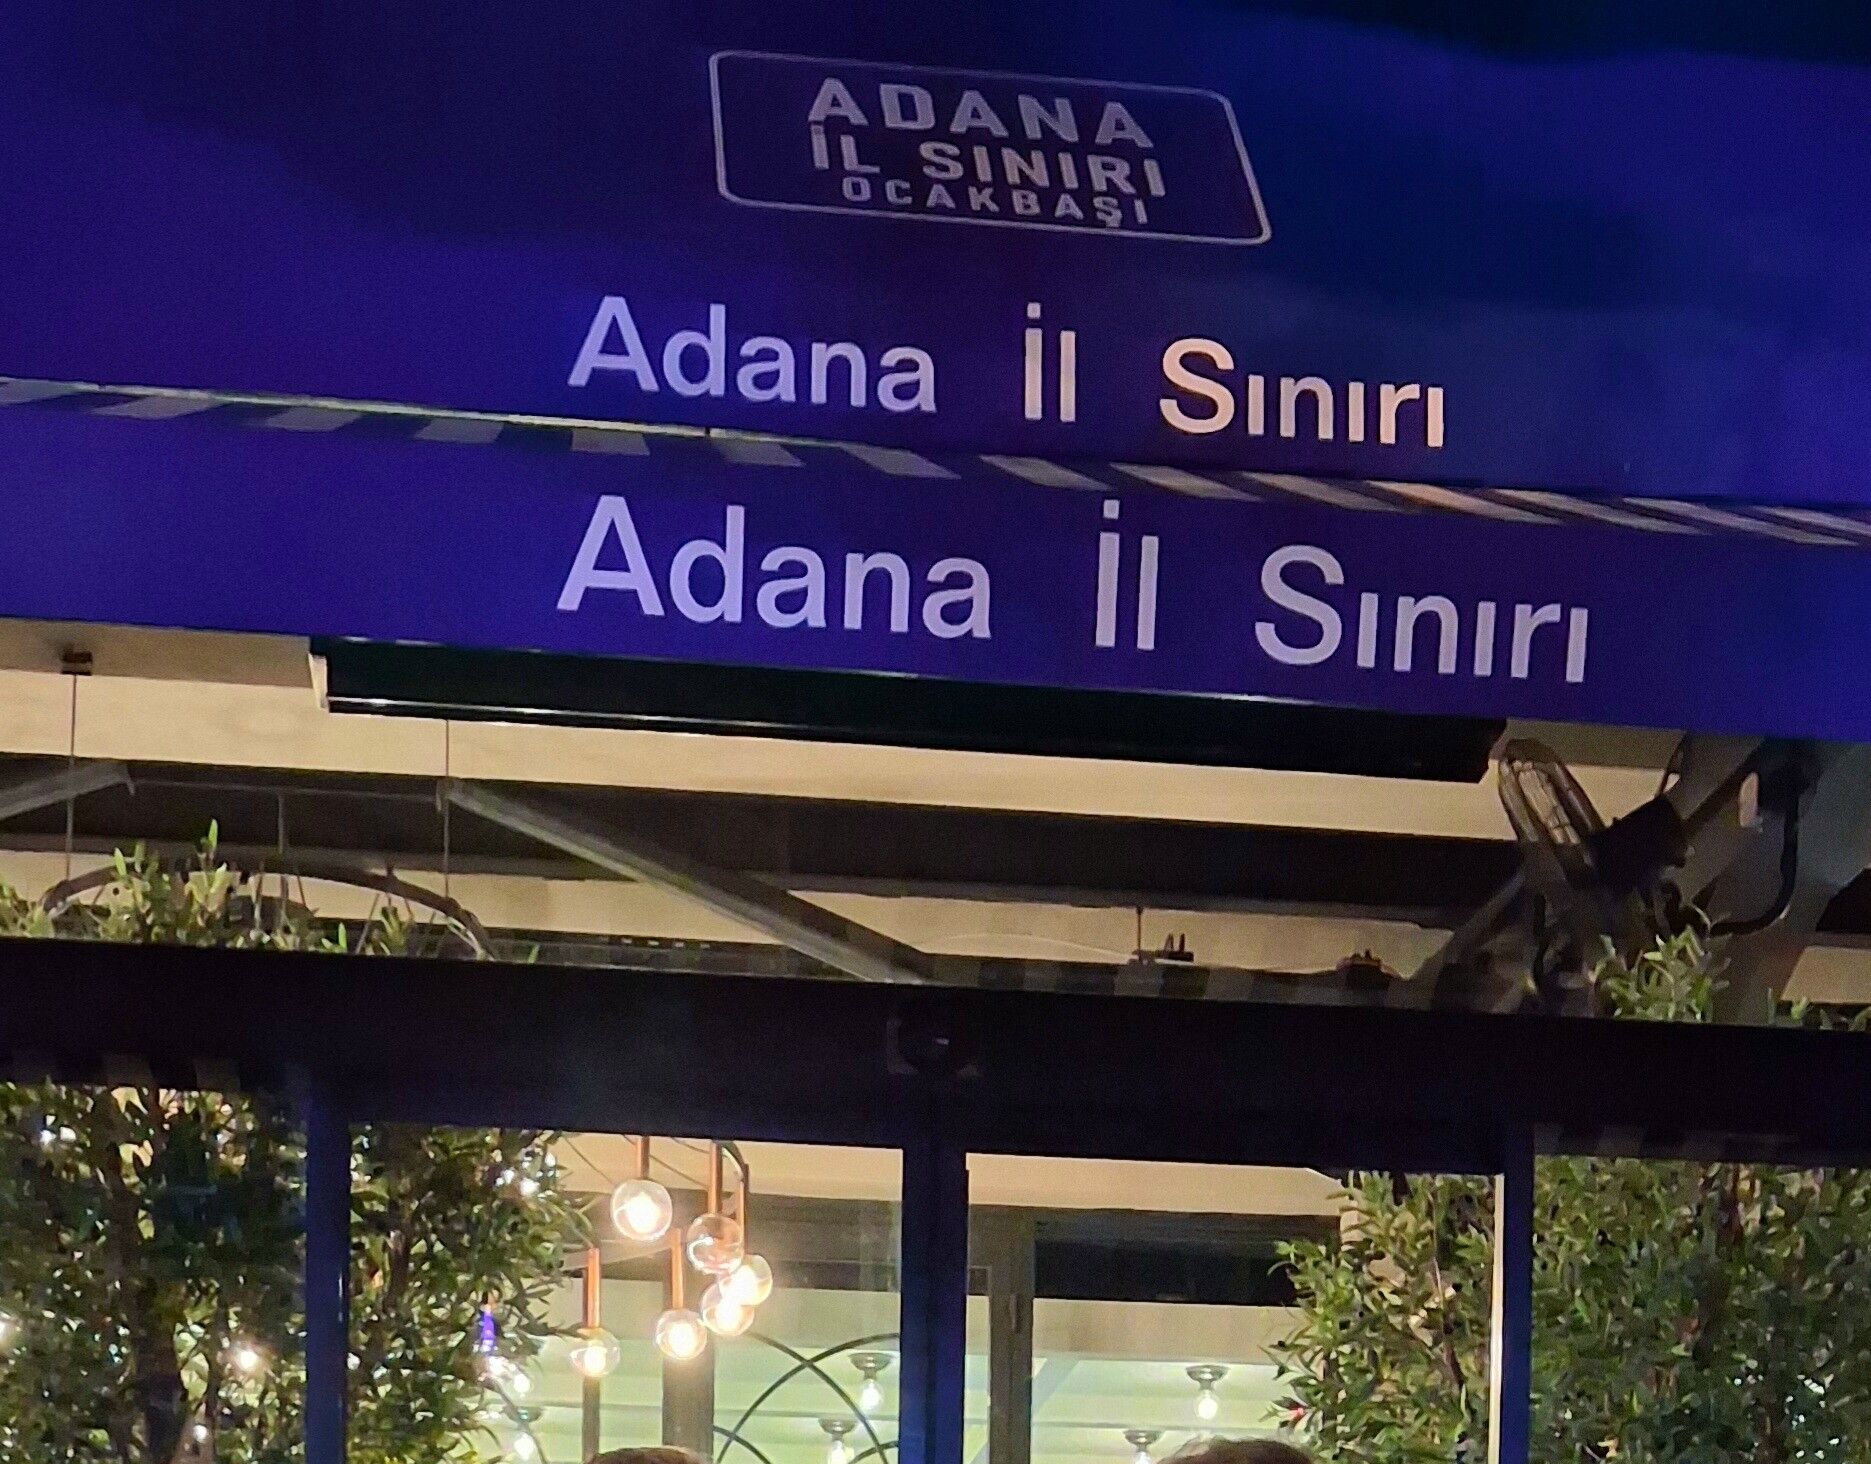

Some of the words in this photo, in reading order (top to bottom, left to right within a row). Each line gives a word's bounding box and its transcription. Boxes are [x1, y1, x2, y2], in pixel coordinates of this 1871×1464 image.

[808, 78, 1153, 149] ADANA
[810, 122, 881, 172] İL
[919, 140, 1166, 198] SINIRI
[842, 176, 1149, 227] OCAKBAŞI
[567, 296, 937, 413] Adana
[1022, 302, 1077, 423] İl
[1158, 338, 1445, 448] Sınırı
[557, 496, 992, 640] Adana
[1093, 500, 1160, 651] İl
[1254, 546, 1589, 683] Sınırı
